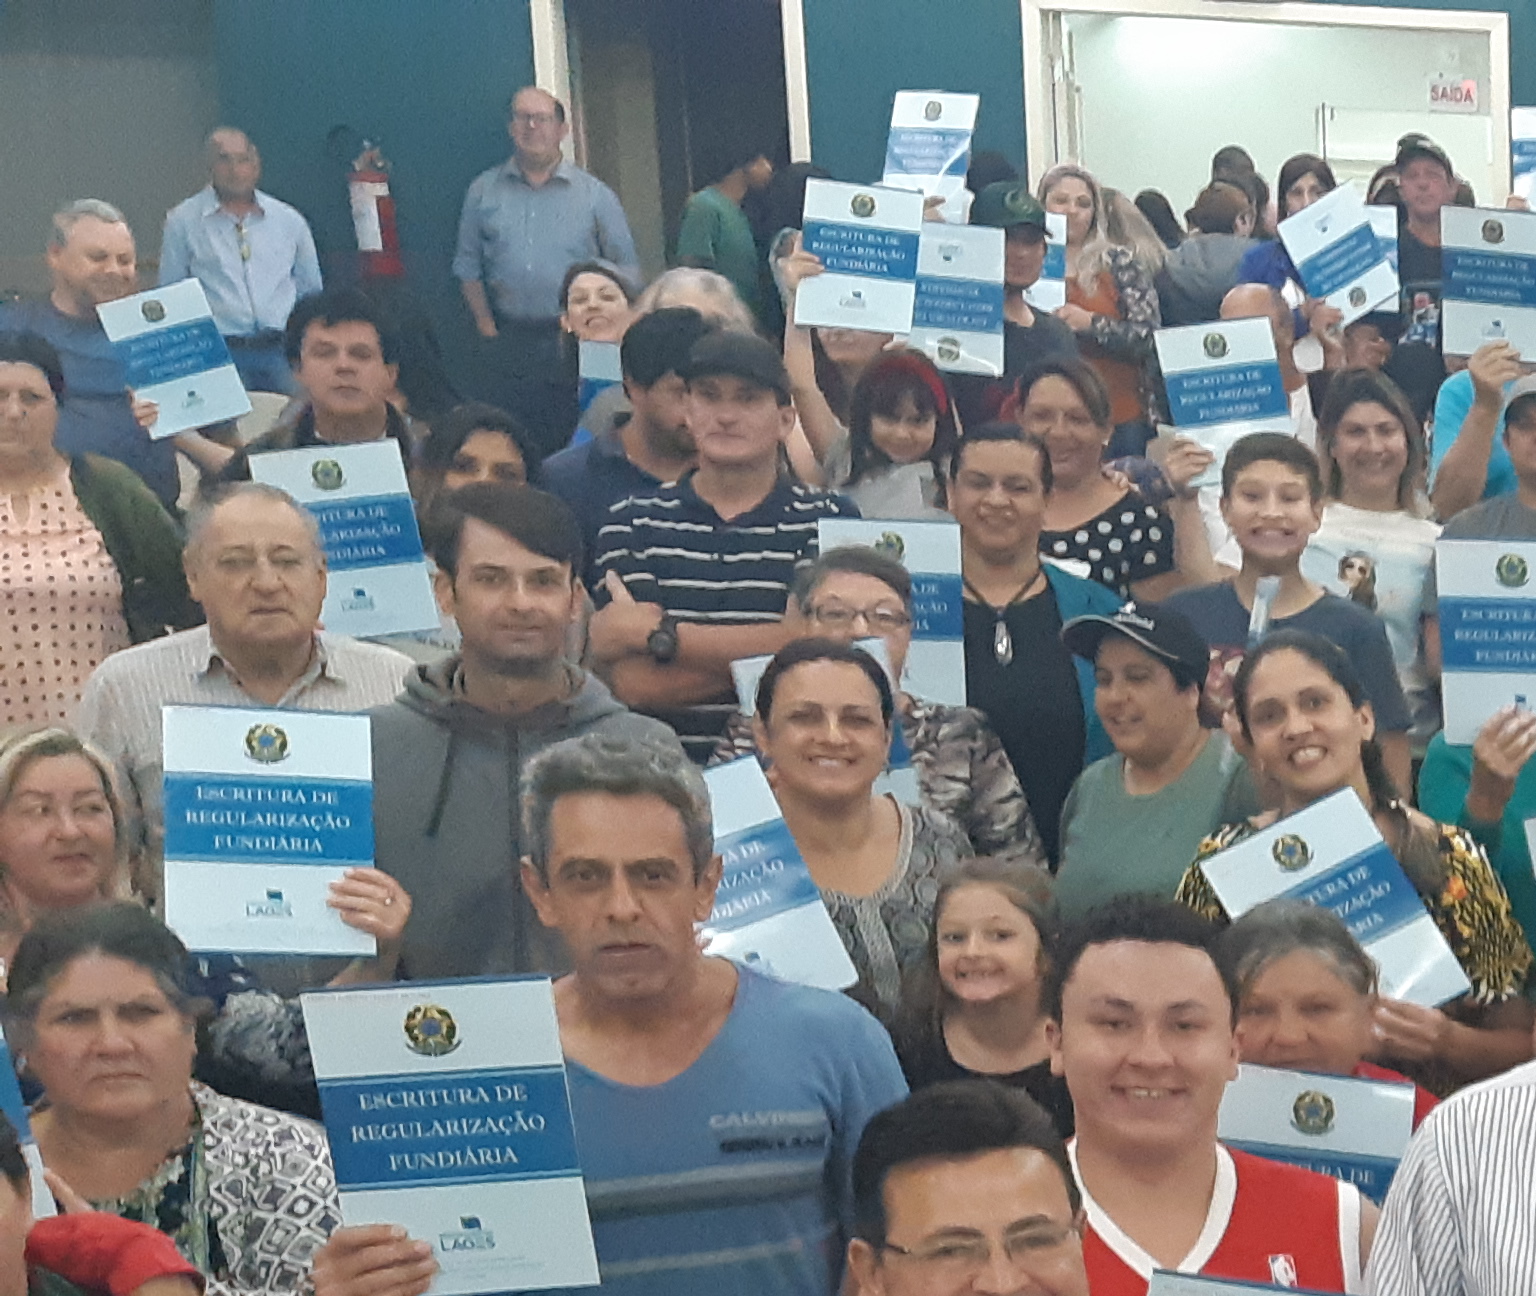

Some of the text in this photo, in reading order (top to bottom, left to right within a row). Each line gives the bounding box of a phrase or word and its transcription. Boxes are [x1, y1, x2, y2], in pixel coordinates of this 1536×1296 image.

[320, 508, 364, 524] ITURA
[324, 523, 401, 540] LARIZAÇÃO
[327, 543, 387, 558] NDIÁRIA
[196, 785, 338, 805] ESCRITURA DE
[185, 809, 349, 831] REGULARIZAÇÃO
[213, 835, 322, 853] FUNDIÁRIA
[357, 1083, 527, 1111] ESCRITURA DE
[350, 1111, 545, 1145] REGULARIZAÇÃO
[388, 1144, 518, 1172] FUNDIÁRIA
